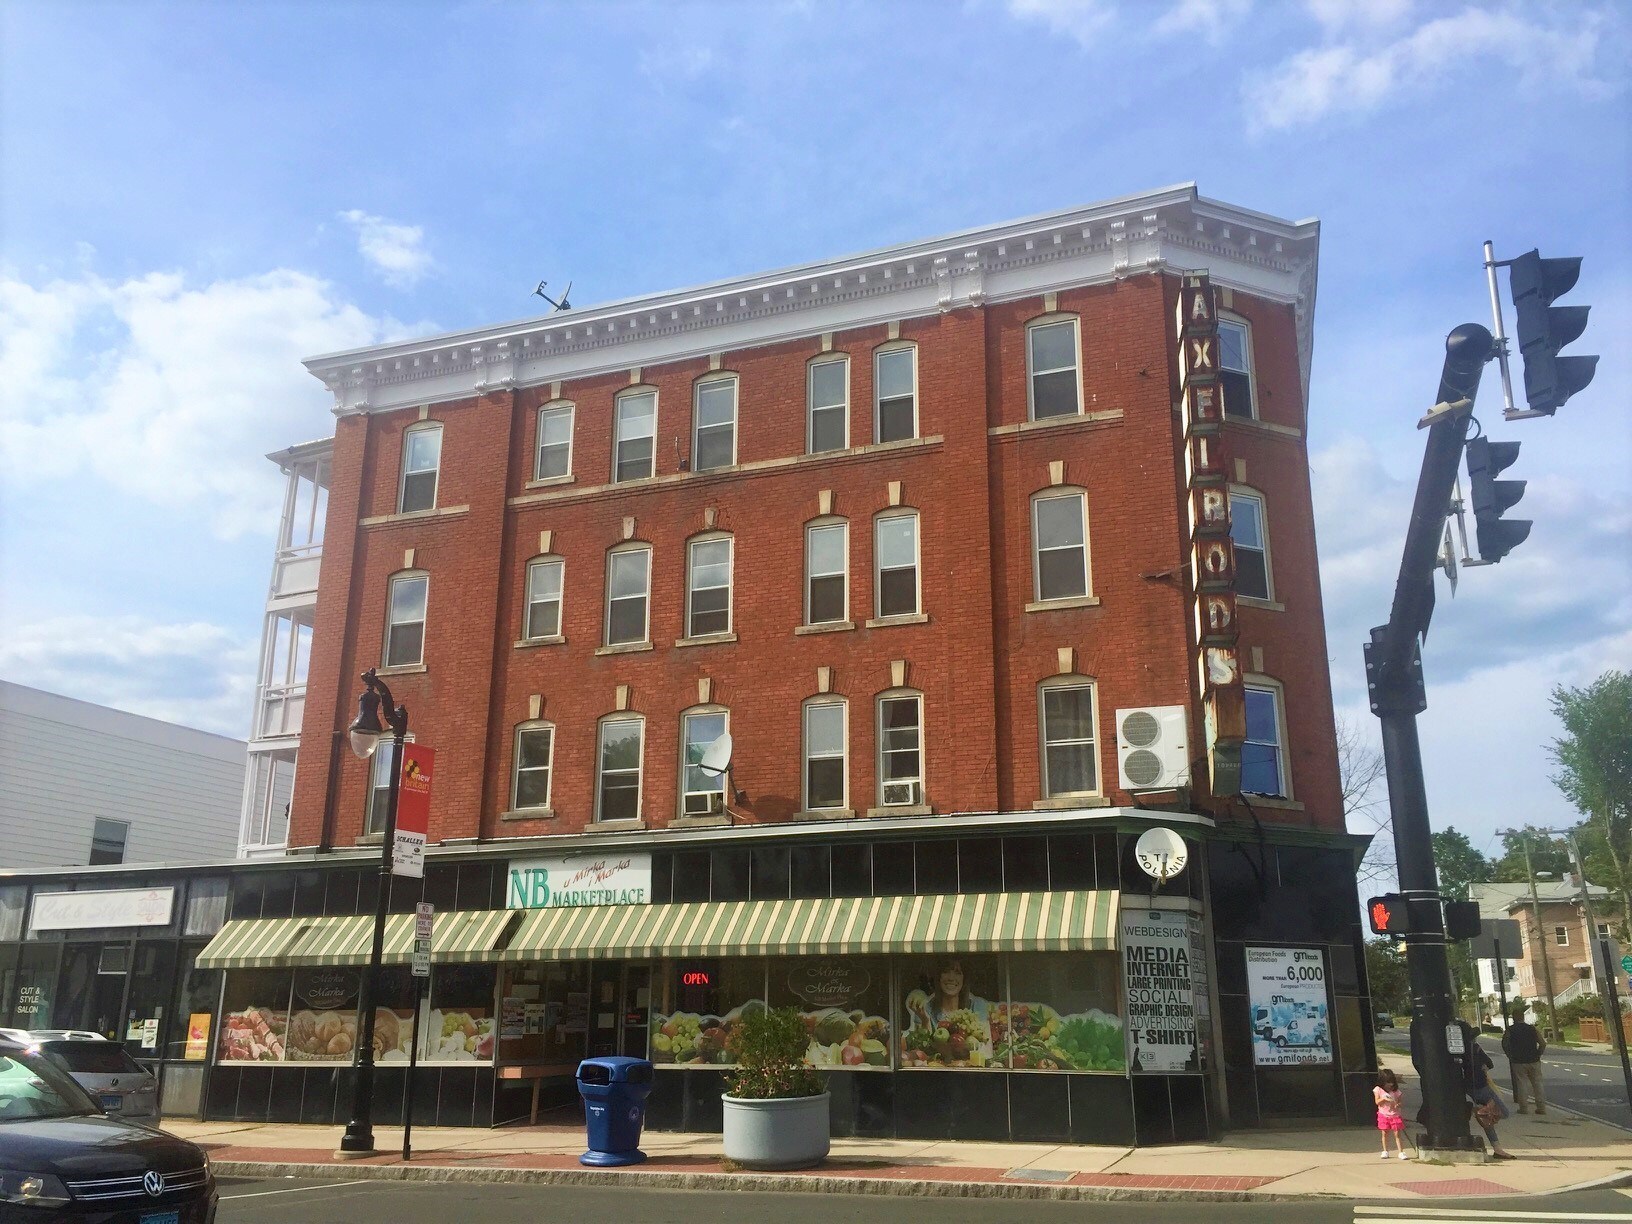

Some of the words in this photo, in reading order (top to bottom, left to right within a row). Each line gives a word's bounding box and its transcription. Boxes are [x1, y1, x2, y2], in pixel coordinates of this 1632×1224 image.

[405, 778, 430, 790] britain
[415, 773, 431, 782] new
[573, 860, 605, 884] Mirka
[595, 859, 631, 884] Marka
[508, 868, 550, 909] NB
[552, 888, 644, 908] MARKETPLACE
[1124, 926, 1188, 938] WEBDESIGN
[1126, 946, 1188, 963] MEDIA
[1126, 962, 1189, 977] INTERNET
[1287, 966, 1323, 983] 6,000
[683, 972, 709, 985] OPEN
[1127, 976, 1152, 990] LARGE
[1153, 977, 1191, 991] PRINTING
[20, 986, 34, 994] CUT
[35, 986, 40, 994] &
[805, 982, 852, 994] Marka
[19, 995, 39, 1004] STYLE
[1129, 989, 1188, 1004] SOCIAL
[17, 1005, 39, 1014] SALON
[1128, 1003, 1163, 1016] GRAPHIC
[1165, 1004, 1194, 1017] DESIGN
[1130, 1016, 1194, 1030] ADVERTISING
[1130, 1029, 1195, 1046] T-SHIRT
